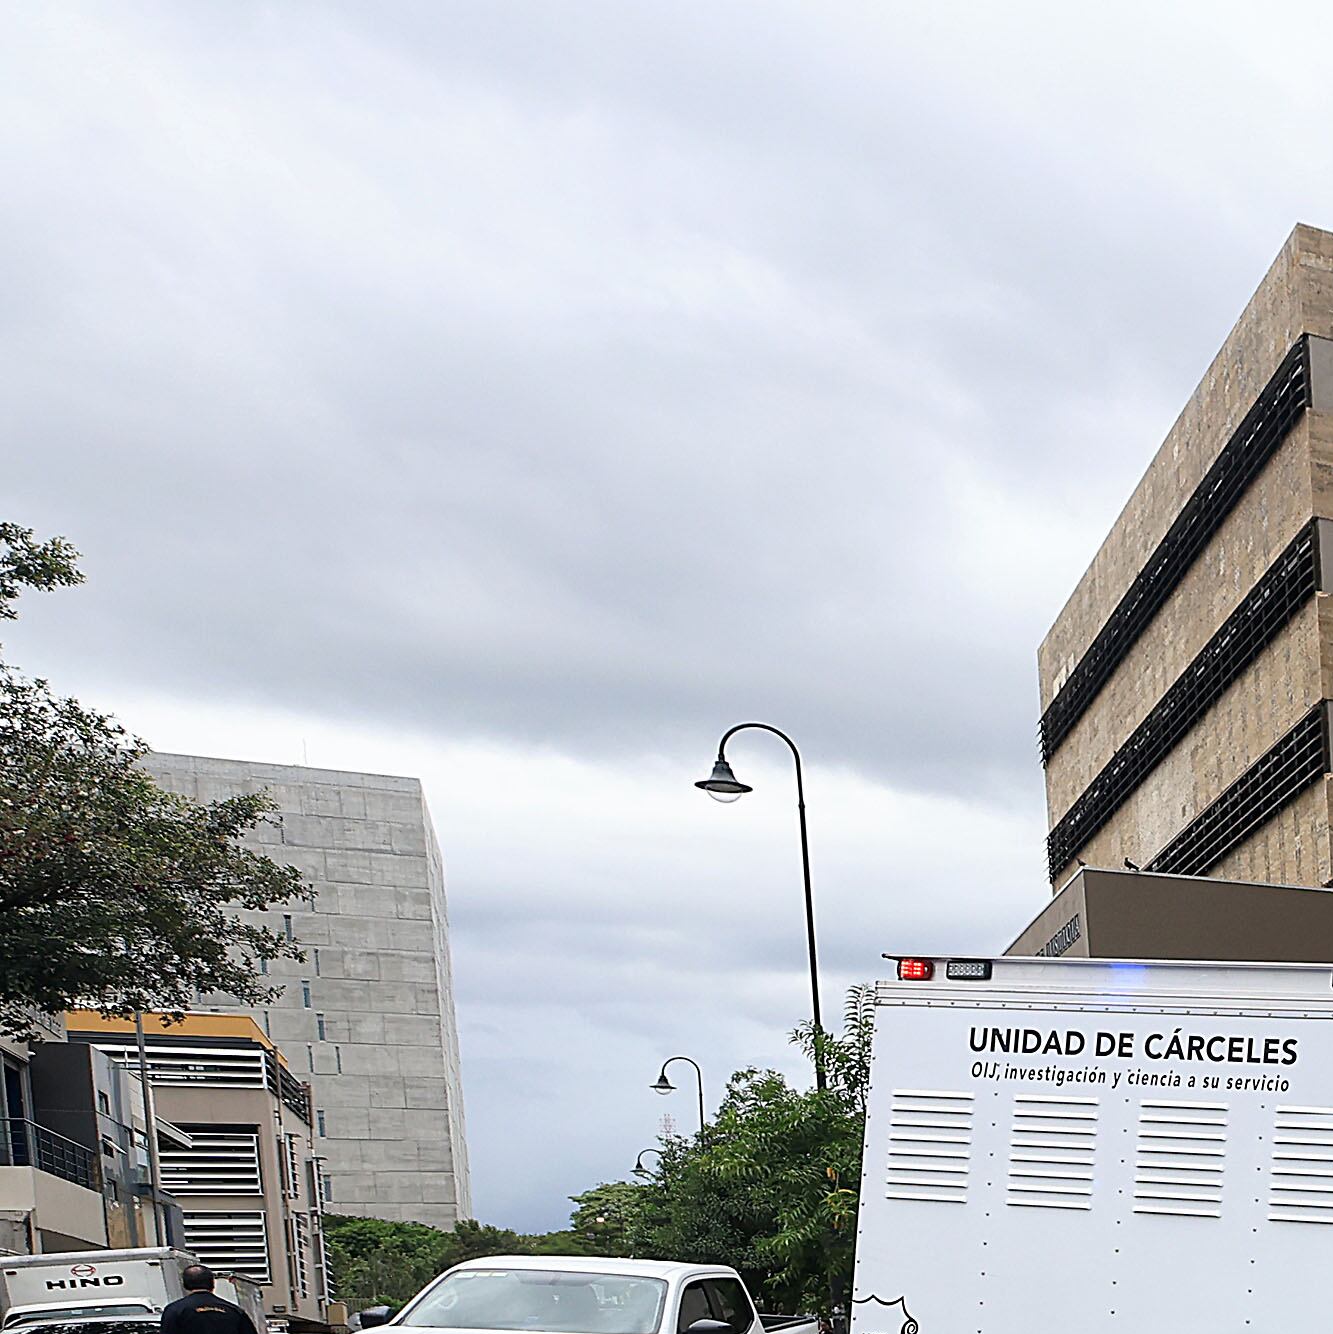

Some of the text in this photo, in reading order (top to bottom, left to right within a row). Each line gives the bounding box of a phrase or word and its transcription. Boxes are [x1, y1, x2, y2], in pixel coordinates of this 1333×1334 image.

[970, 1028, 1297, 1065] UNIDAD DE CÁRCELES
[1004, 1063, 1106, 1088] investigación
[1112, 1073, 1121, 1089] y
[1128, 1071, 1181, 1088] ciencia
[1188, 1077, 1196, 1089] a
[1203, 1077, 1220, 1090] su
[1227, 1075, 1290, 1093] servicio
[46, 1275, 124, 1291] HINO
